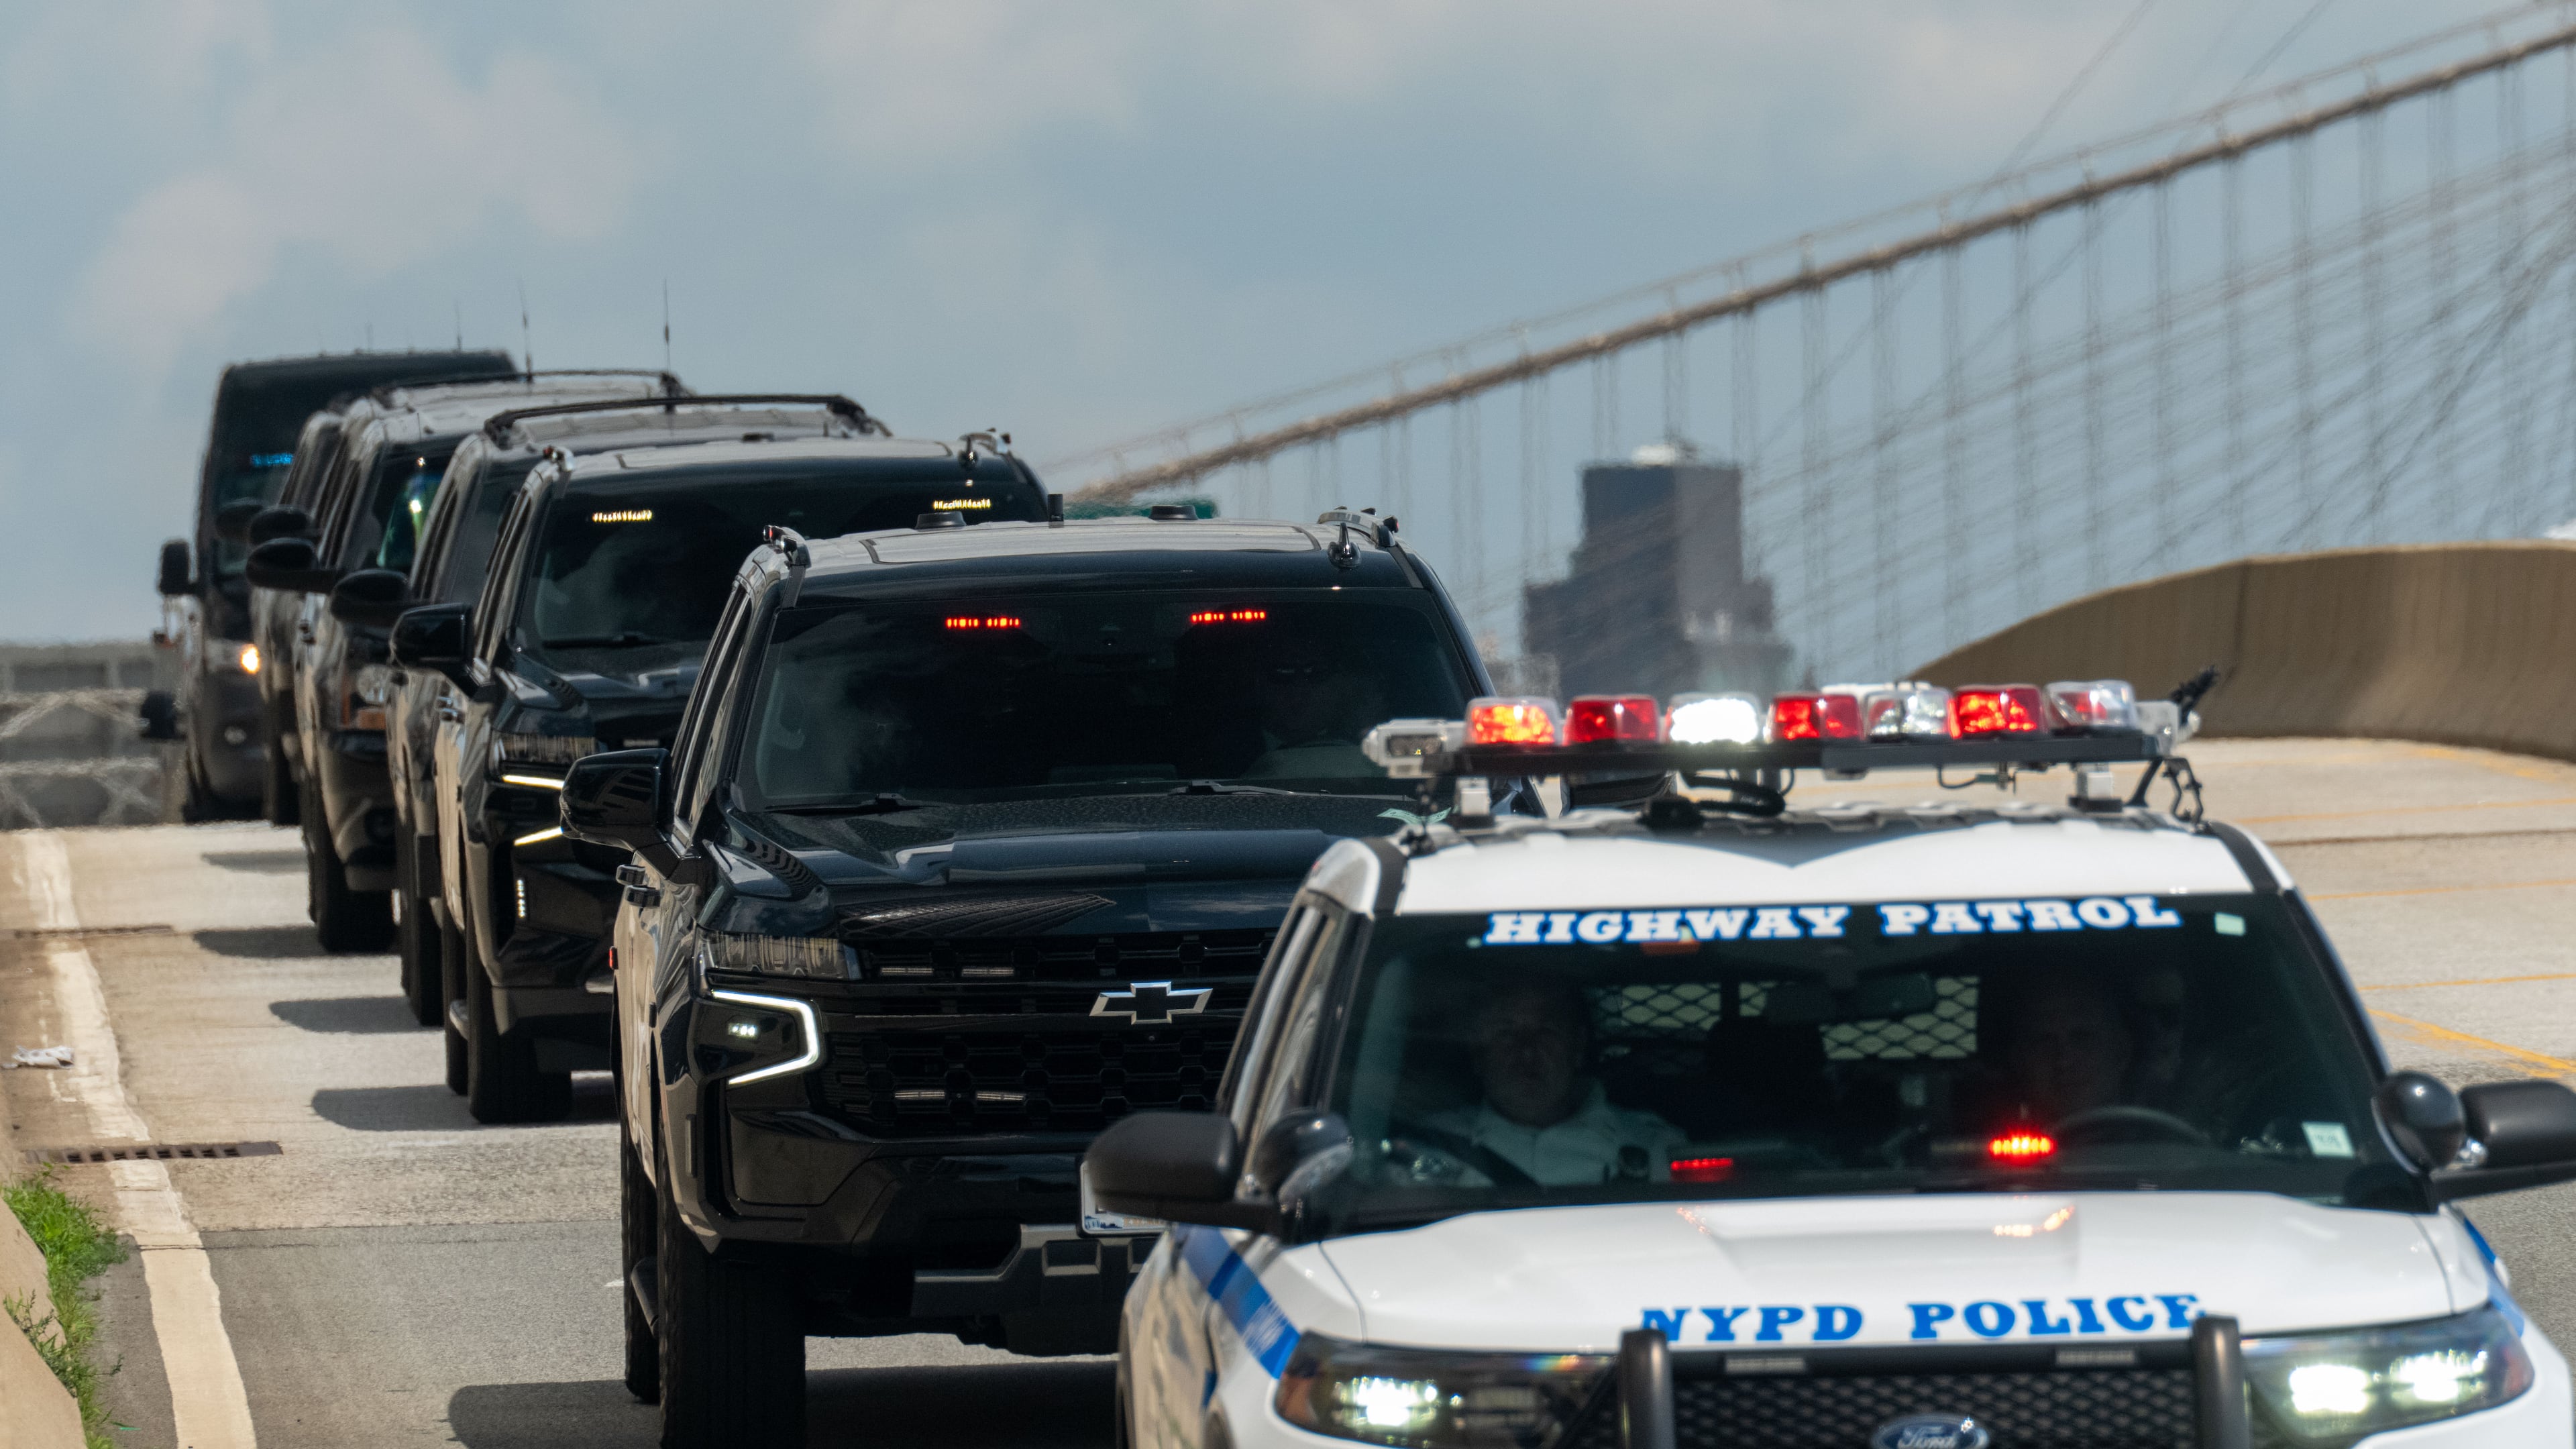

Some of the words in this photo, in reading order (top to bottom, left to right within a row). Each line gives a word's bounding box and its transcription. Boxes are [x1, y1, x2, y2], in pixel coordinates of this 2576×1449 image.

[1482, 906, 1852, 945] HIGHWAY
[1876, 897, 2183, 936] PATROL
[1641, 1304, 1864, 1342] NYPD
[1907, 1294, 2206, 1340] POLICE
